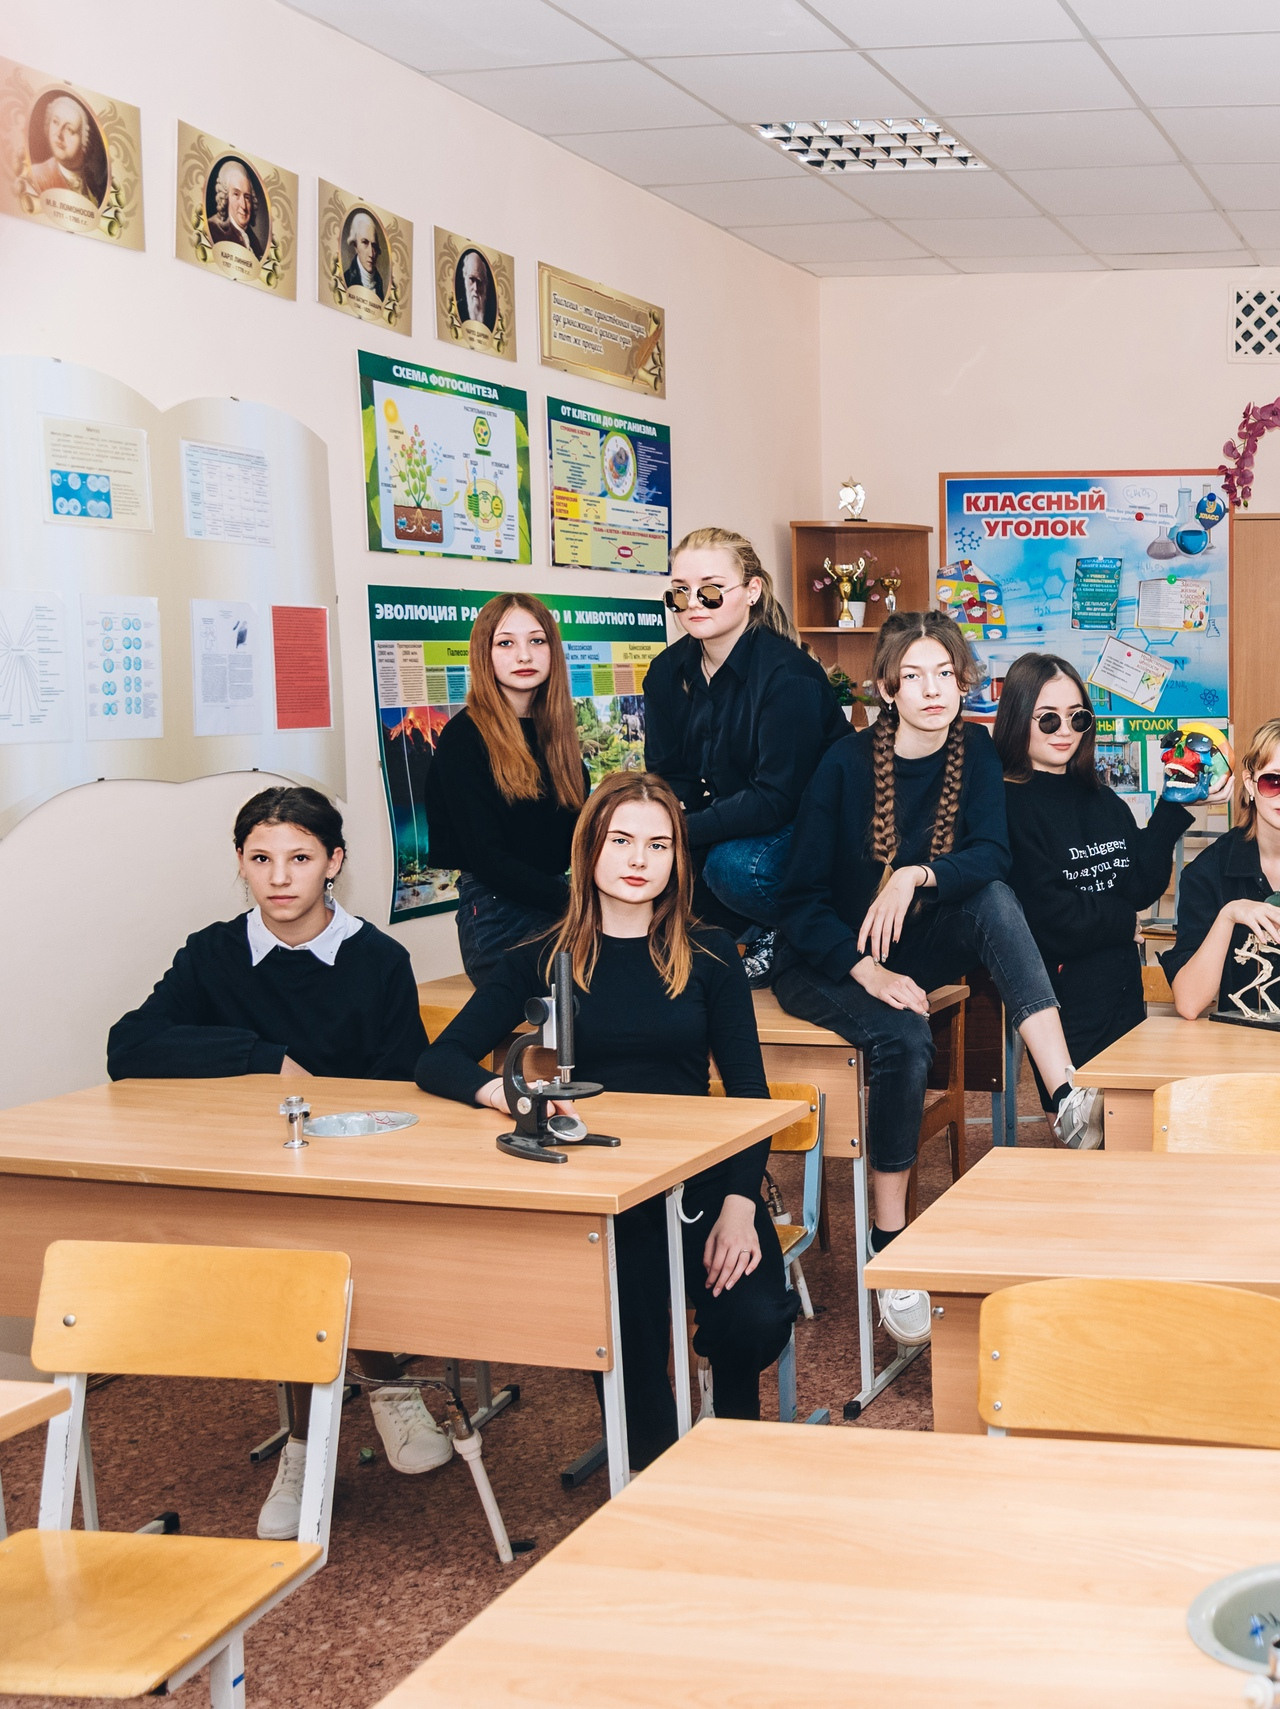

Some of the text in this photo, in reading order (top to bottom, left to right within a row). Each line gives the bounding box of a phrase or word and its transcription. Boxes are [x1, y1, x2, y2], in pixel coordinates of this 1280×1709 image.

[59, 202, 95, 219] ЛОМОНОСОВ
[392, 365, 500, 401] СХЕМА ФОТОСИНТЕЗА
[561, 405, 658, 437] ОТ КЛЕТКИ ДО ОРГАНИЗМА
[965, 489, 1106, 512] КЛАССНЫЙ
[983, 519, 1087, 538] УГОЛОК
[374, 603, 457, 624] ЭВОЛЮЦИЯ
[563, 610, 572, 624] И
[574, 610, 635, 626] ЖИВОТНОГО
[637, 612, 664, 627] МИРА
[1174, 659, 1185, 672] N
[1129, 719, 1175, 731] УГОЛОК
[1090, 861, 1112, 878] you
